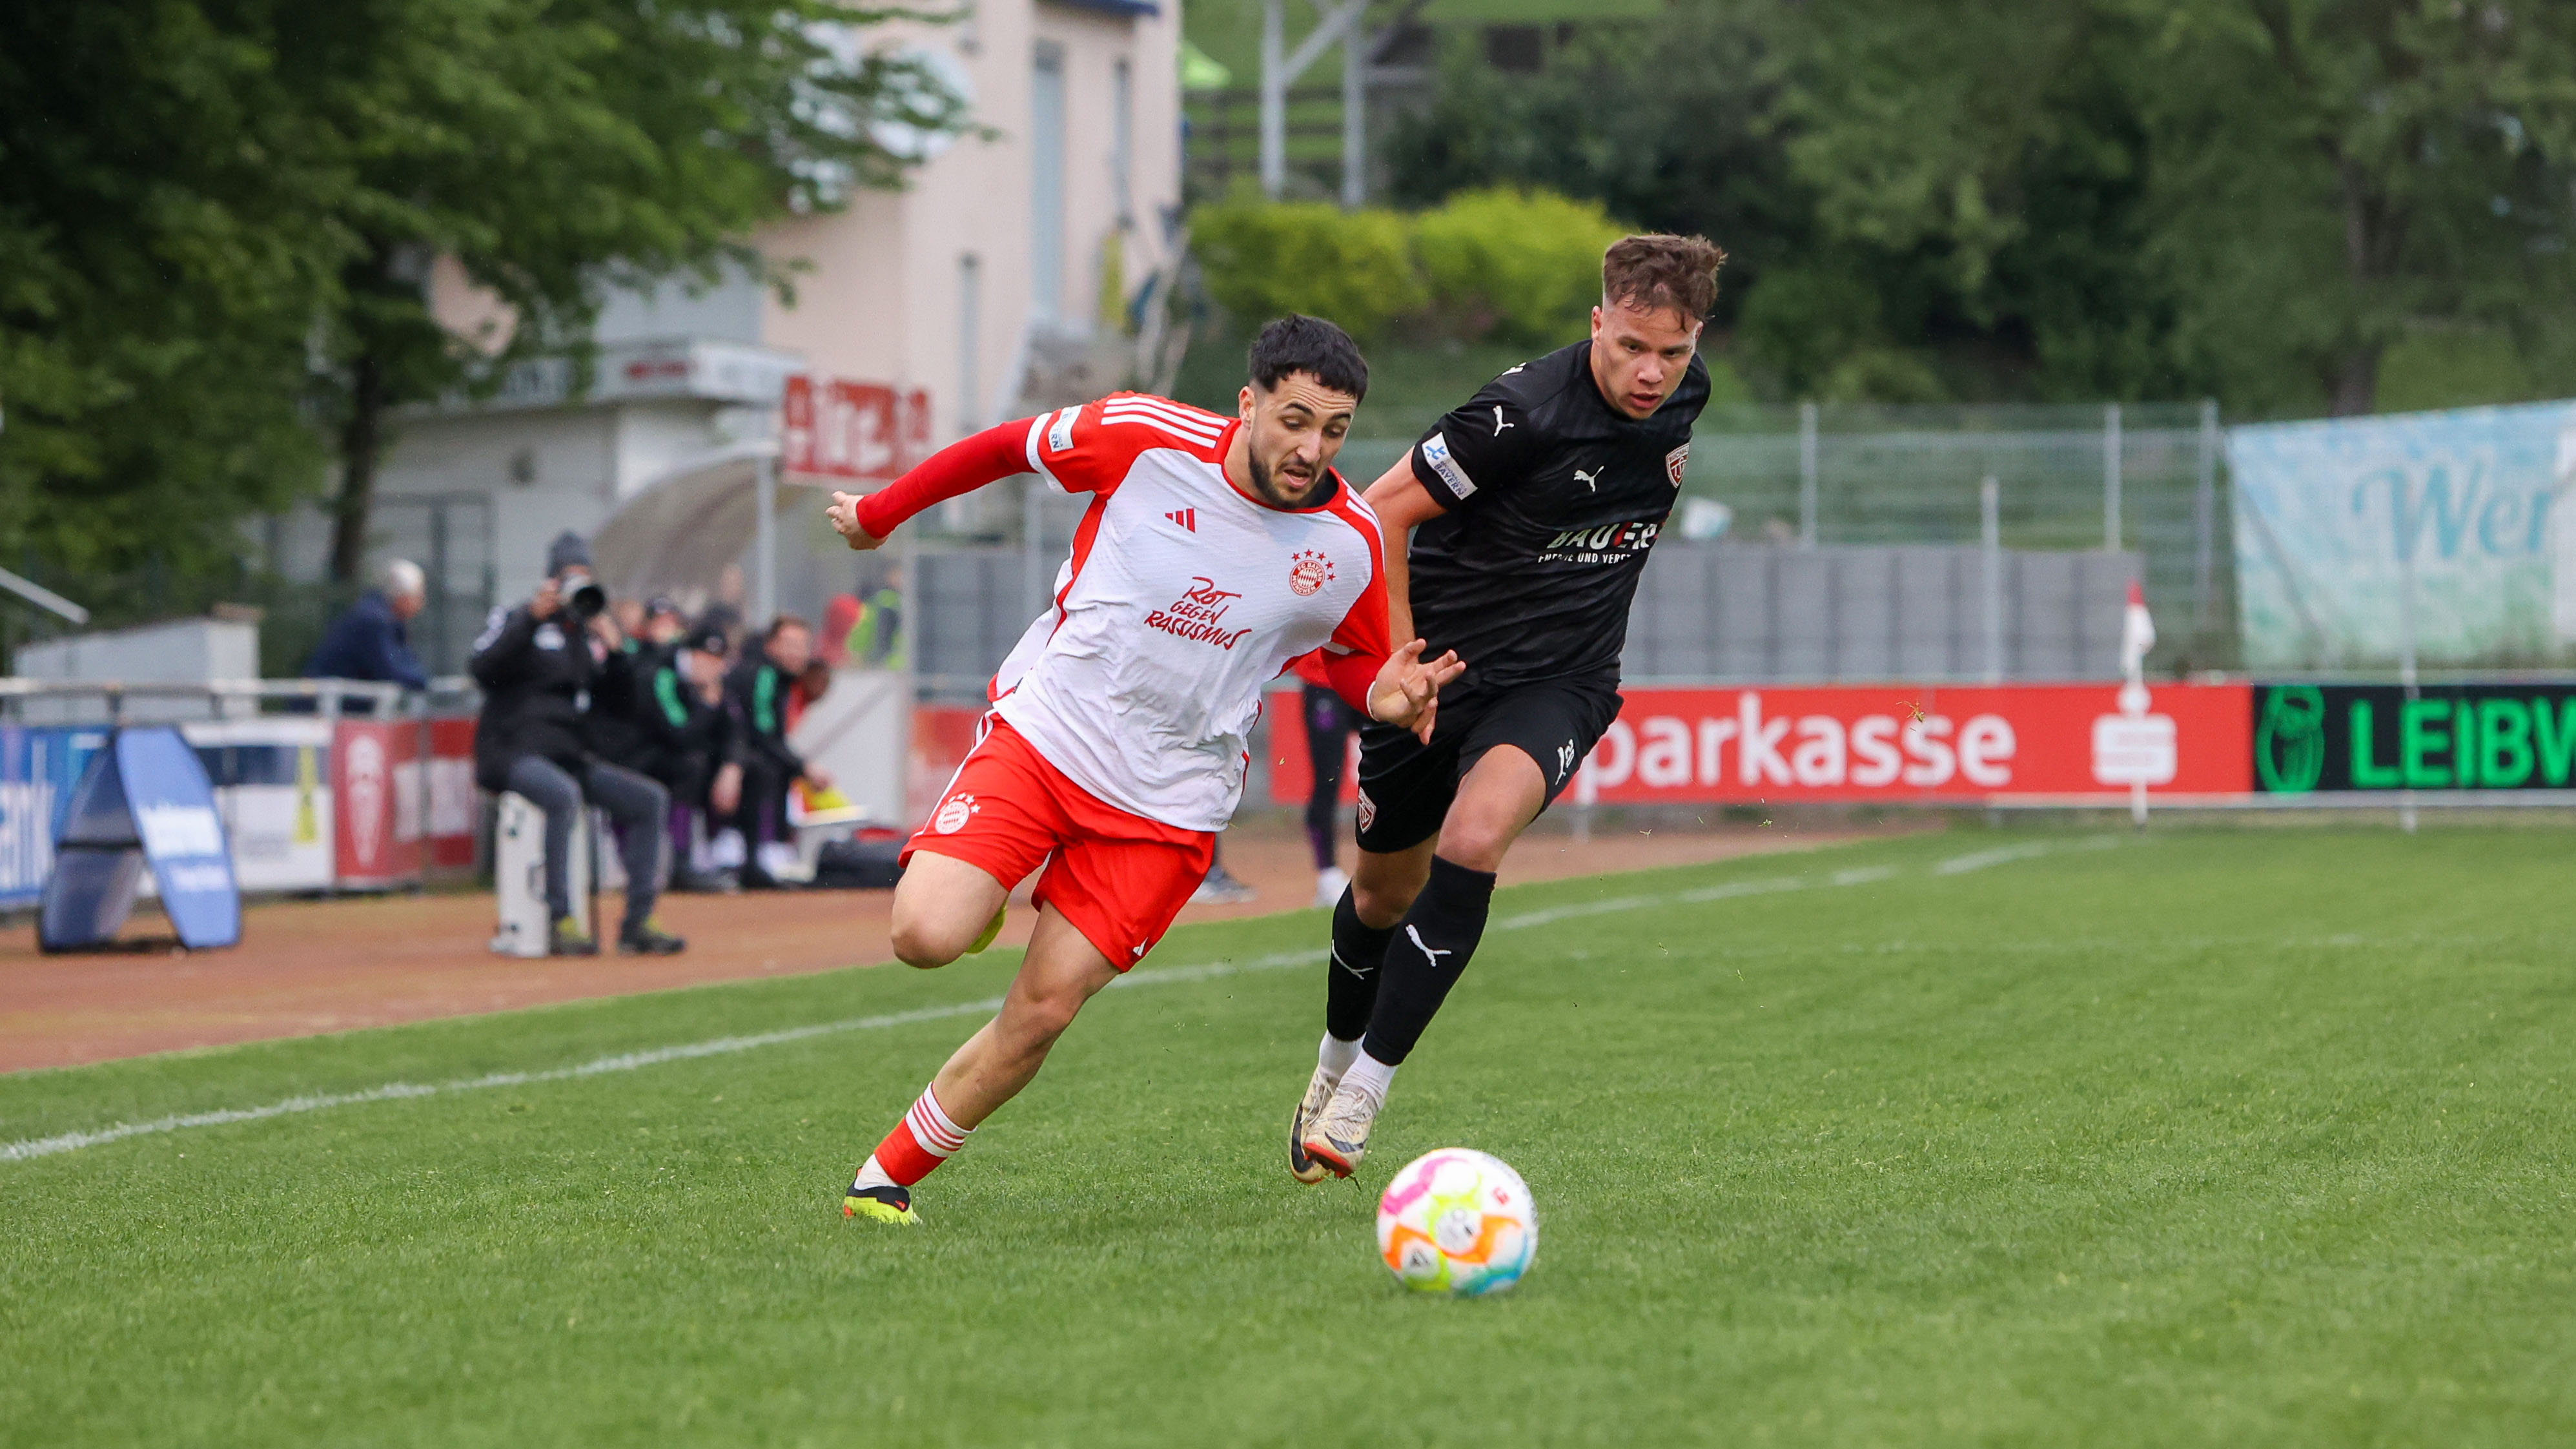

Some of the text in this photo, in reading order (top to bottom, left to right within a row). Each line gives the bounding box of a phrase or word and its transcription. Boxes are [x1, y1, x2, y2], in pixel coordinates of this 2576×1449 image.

[1434, 464, 1465, 496] BAYERN
[1577, 552, 1599, 563] UND
[1170, 601, 1230, 624] GEGEN
[1143, 610, 1252, 650] RASSISMUS
[1575, 692, 2017, 808] parkasse
